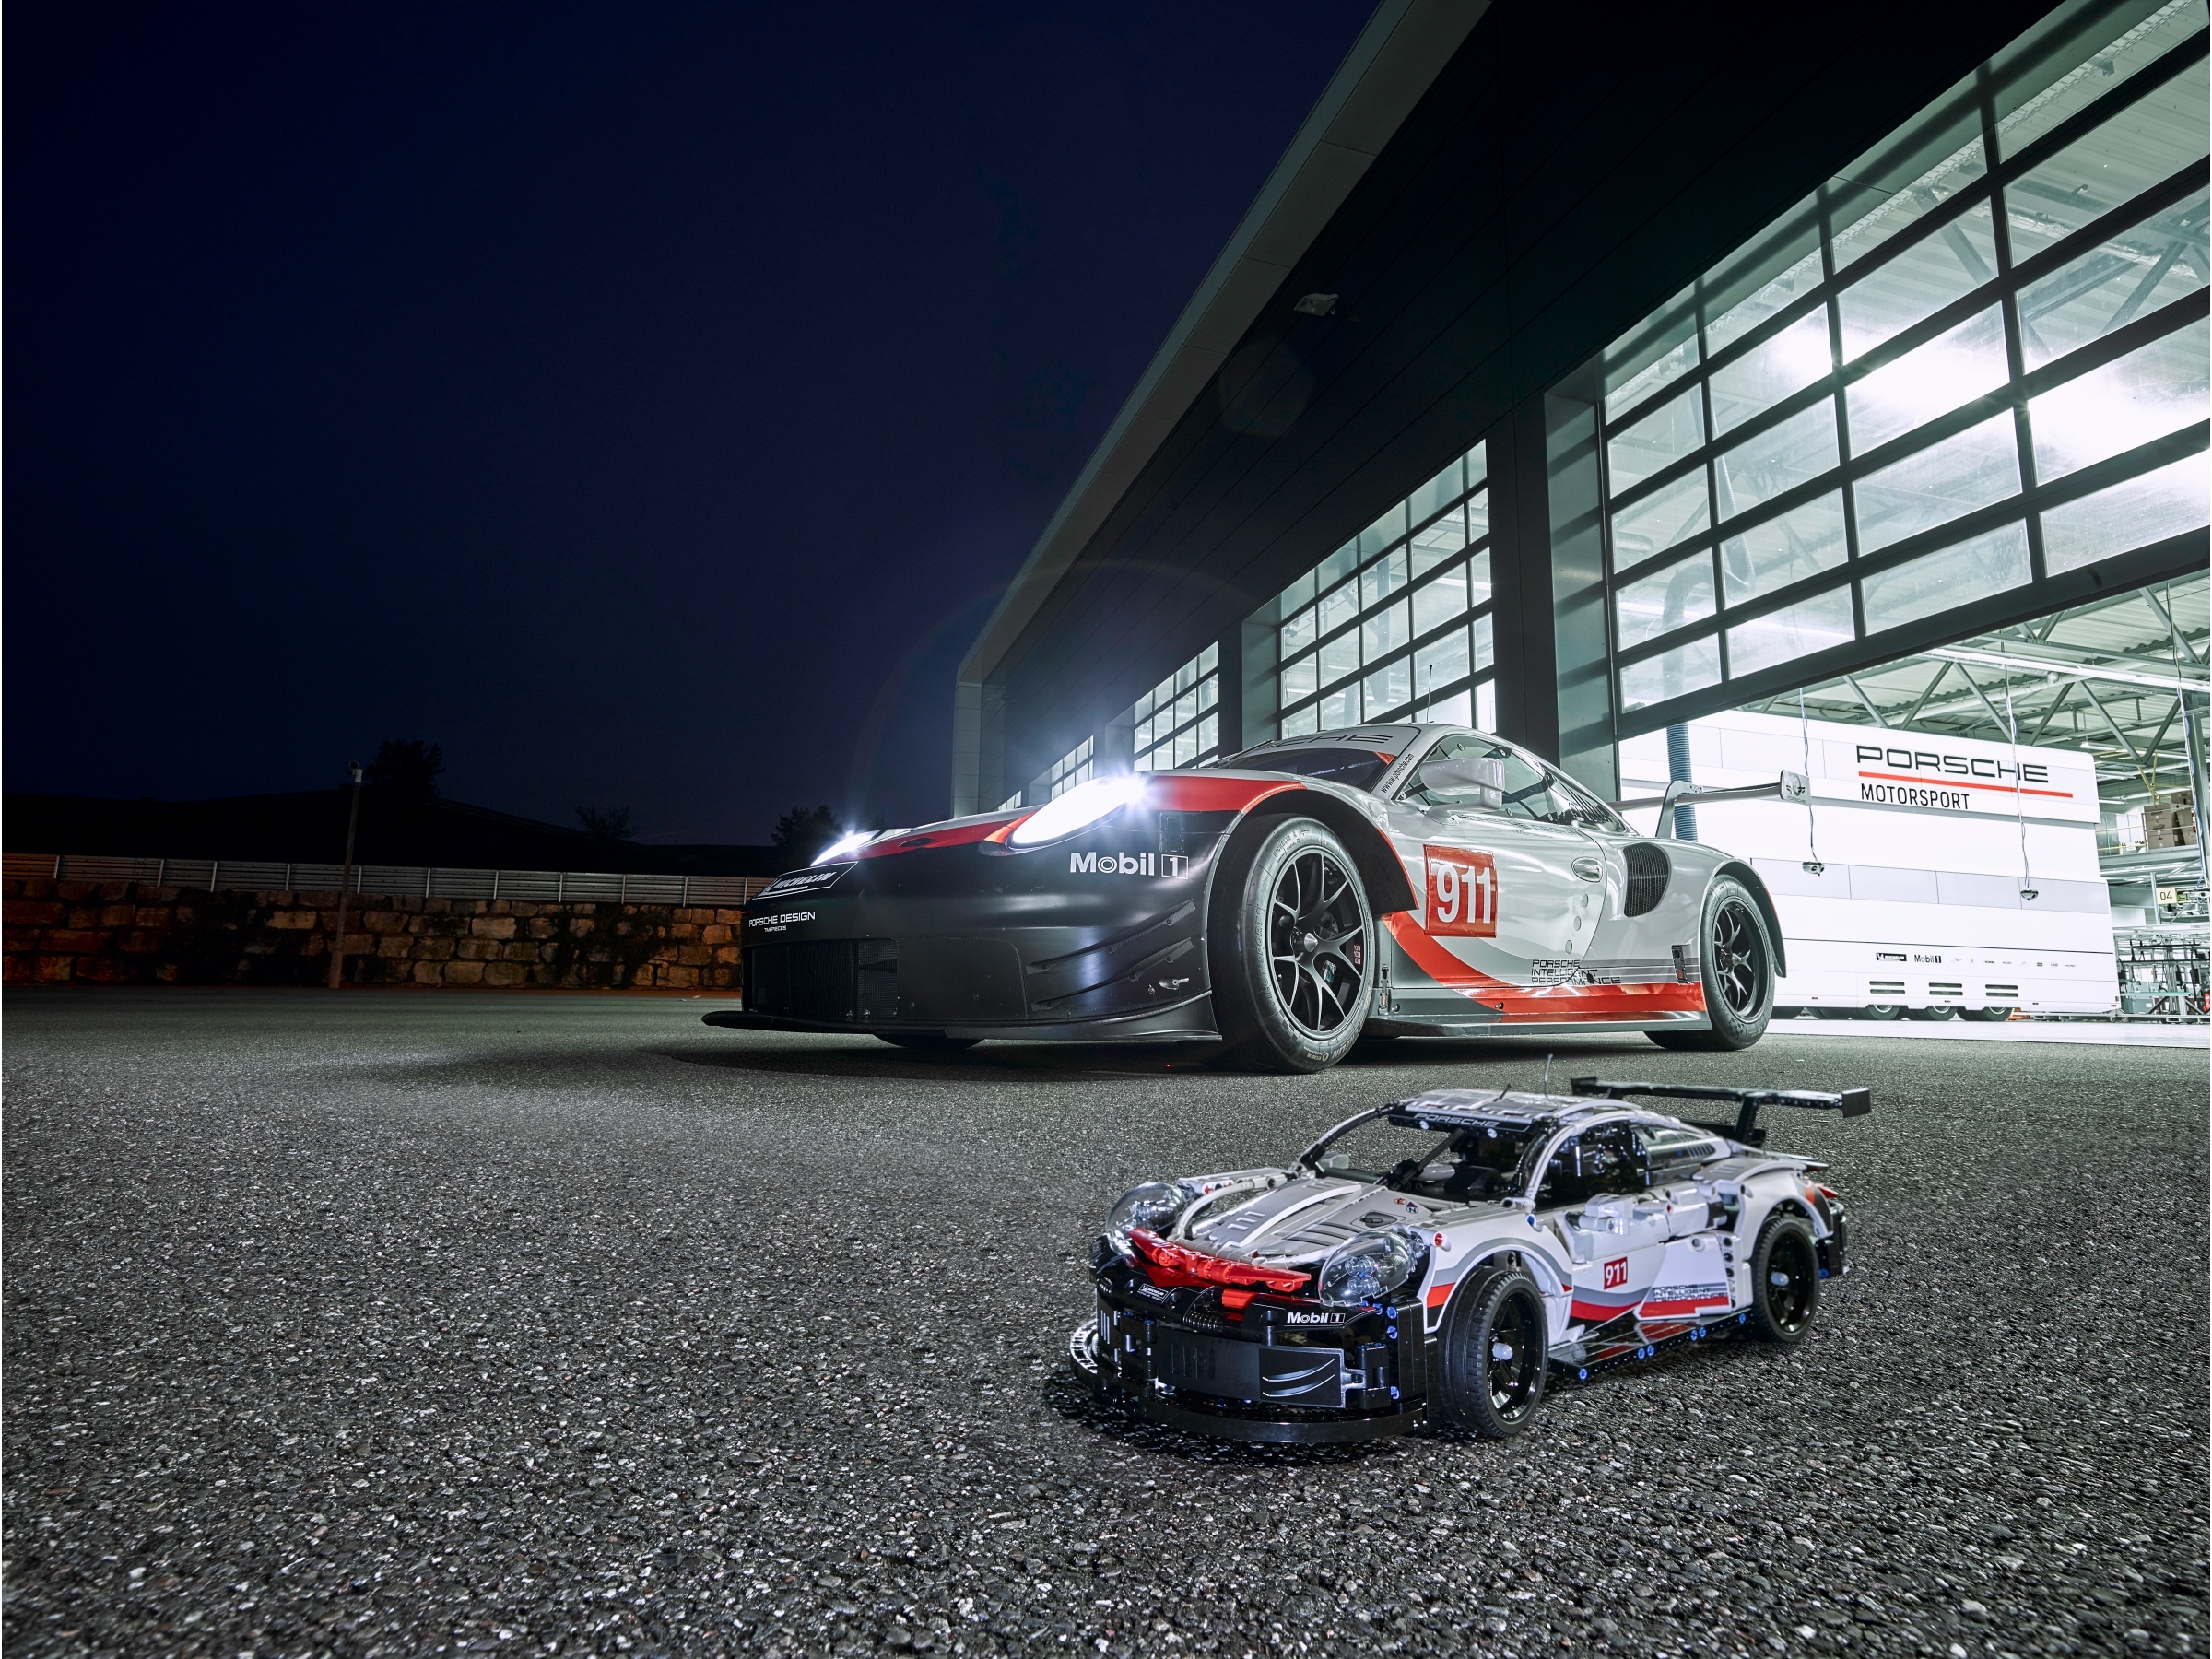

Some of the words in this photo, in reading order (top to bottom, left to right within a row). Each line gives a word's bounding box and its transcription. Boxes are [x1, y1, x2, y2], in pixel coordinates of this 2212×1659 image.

[1856, 745, 2049, 783] PORSCHE
[1381, 753, 1414, 793] www.porsche.com
[1861, 783, 1970, 810] MOTORSPORT
[1070, 852, 1155, 876] Mobil
[1437, 864, 1491, 924] 911
[2159, 891, 2173, 900] 04
[748, 915, 779, 927] PORSCHE
[780, 911, 816, 923] DESIGN
[1532, 959, 1580, 968] PORSCHE
[1914, 954, 1935, 963] Mobil
[1531, 968, 1598, 977] INTELLIGENT
[1414, 1112, 1500, 1128] PORSCHE
[1605, 1261, 1627, 1287] 911
[1653, 1284, 1699, 1292] PORSCHE
[1287, 1312, 1329, 1324] Mobil
